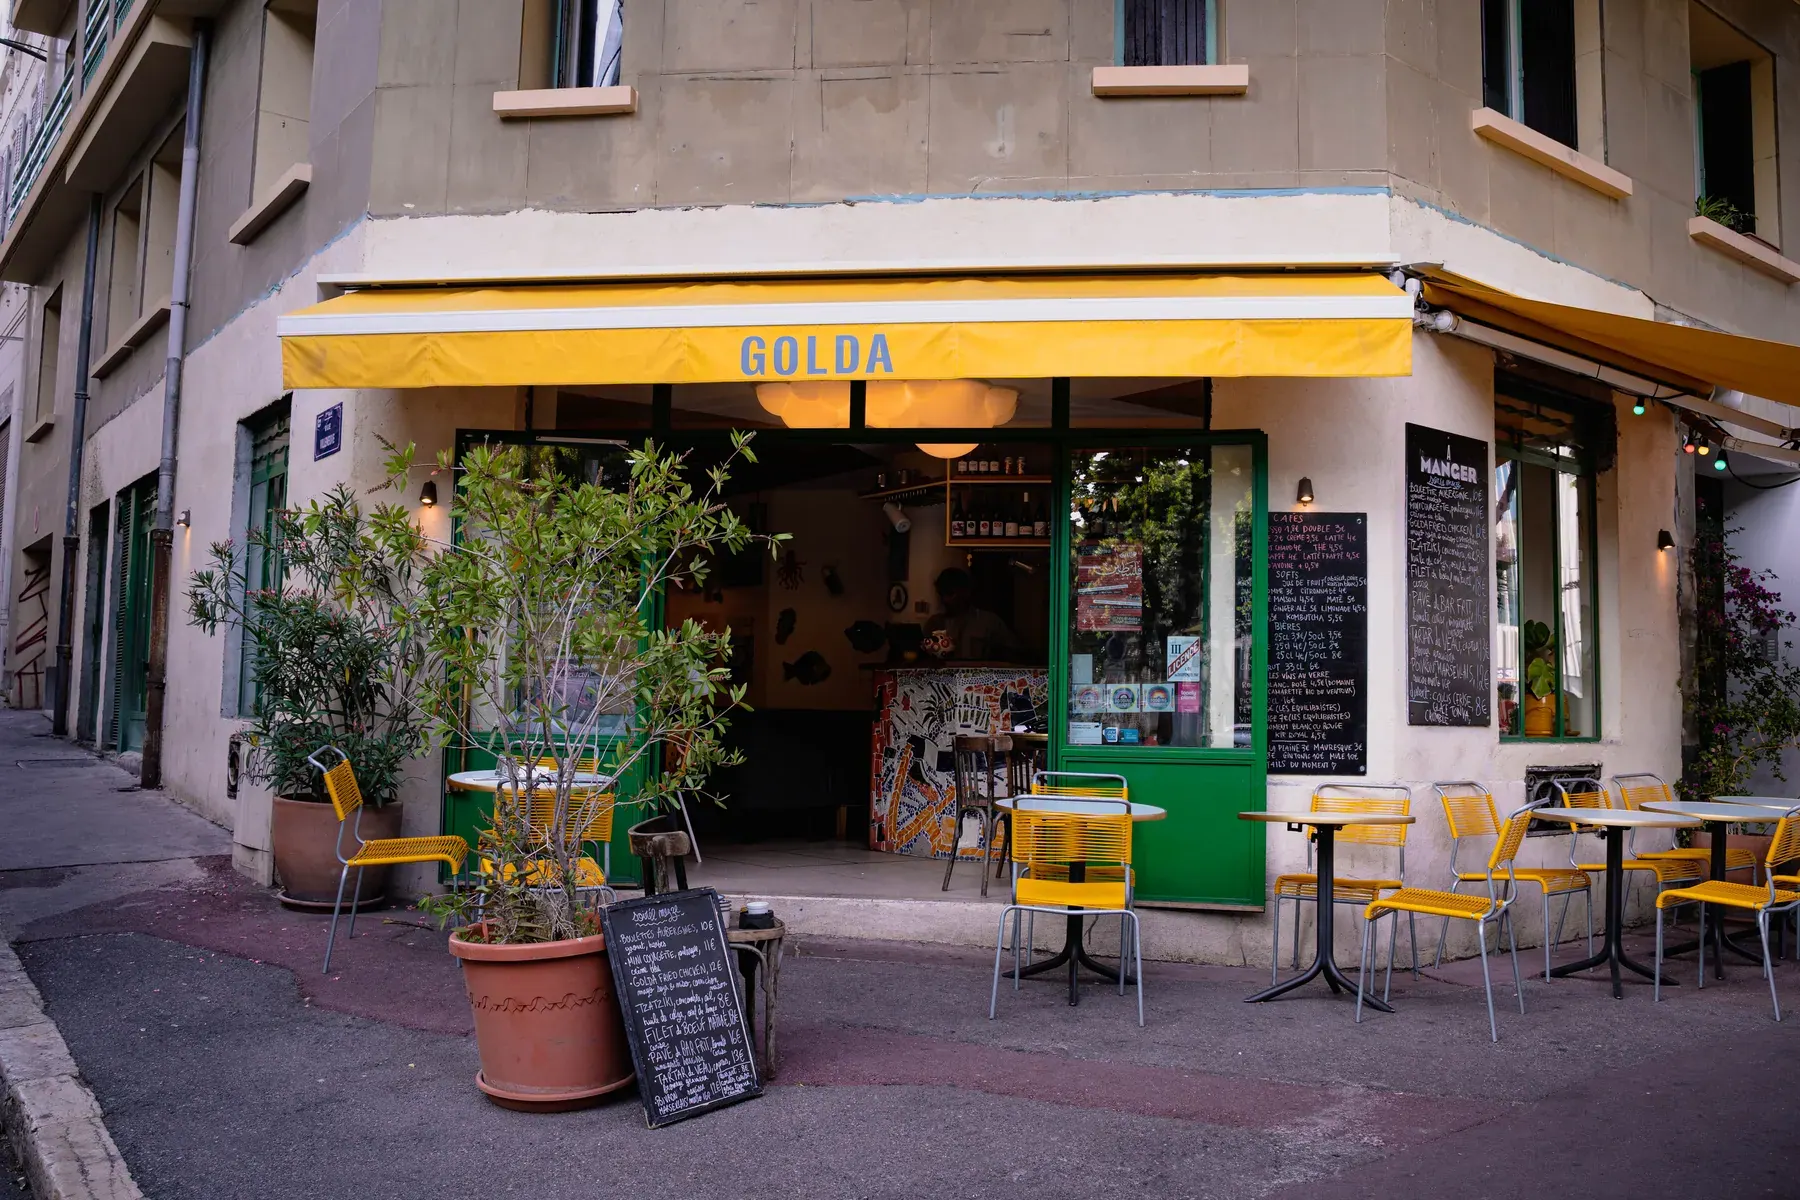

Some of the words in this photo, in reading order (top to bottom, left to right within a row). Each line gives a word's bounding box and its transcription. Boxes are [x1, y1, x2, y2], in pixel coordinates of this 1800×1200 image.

[741, 334, 893, 376] GOLDA
[1447, 445, 1451, 460] A
[1421, 456, 1477, 484] MANGER
[1303, 525, 1330, 533] DOUBLE
[1276, 571, 1299, 579] SOFTS
[1275, 621, 1301, 630] BIÈRES
[1171, 645, 1181, 654] III
[1168, 641, 1199, 676] LICENCE
[1314, 743, 1353, 752] MAURESQUE
[701, 920, 714, 931] 10€
[704, 938, 716, 951] 11€
[632, 974, 656, 987] GOLDA
[659, 970, 678, 982] FRIED
[709, 961, 723, 972] 12€
[717, 993, 733, 1008] 8€
[645, 1024, 674, 1044] FILET
[731, 1049, 744, 1063] 13€
